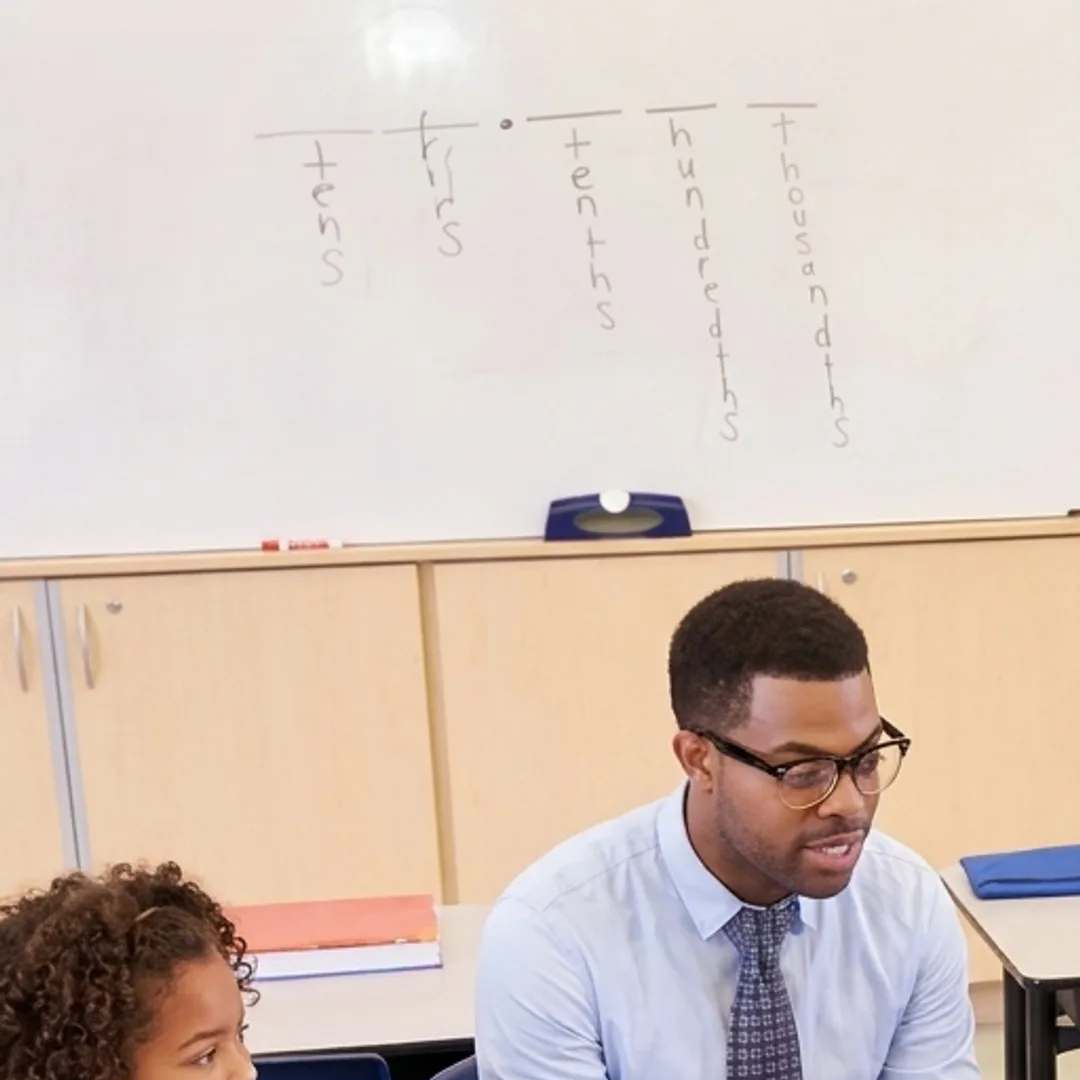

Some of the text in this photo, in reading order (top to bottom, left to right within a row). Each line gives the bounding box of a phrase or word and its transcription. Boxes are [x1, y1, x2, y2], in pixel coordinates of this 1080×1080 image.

[303, 140, 344, 287] tens
[564, 127, 616, 330] tenths
[669, 117, 739, 442] hundredths
